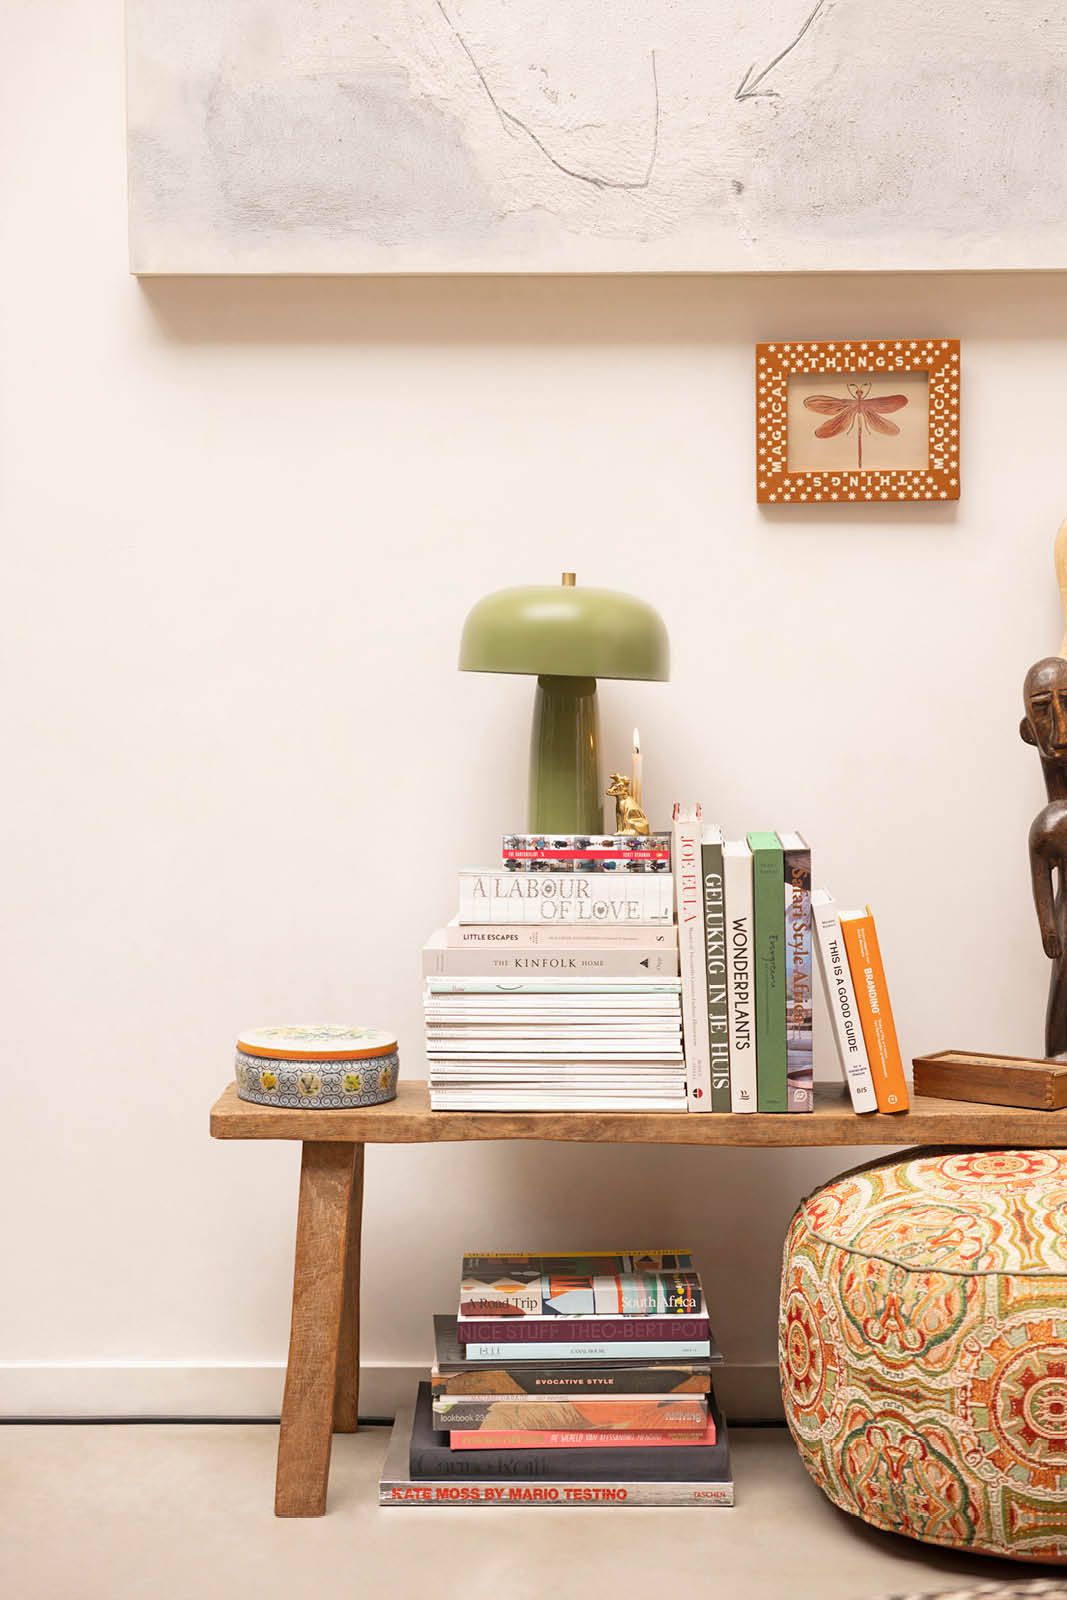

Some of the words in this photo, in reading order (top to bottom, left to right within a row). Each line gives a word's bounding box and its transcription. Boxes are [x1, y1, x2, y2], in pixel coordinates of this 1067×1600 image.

[808, 356, 905, 368] THINGS
[772, 371, 782, 472] MAGICAL
[934, 368, 945, 470] MAGICAL
[813, 475, 908, 487] THINGS
[680, 835, 695, 869] JOE
[472, 878, 488, 898] A
[494, 878, 592, 898] LABOUR
[682, 874, 697, 923] EULA
[791, 868, 810, 918] Safari
[540, 900, 576, 920] OF
[577, 900, 640, 920] LOVE
[704, 873, 726, 974] GELUKKIG
[463, 933, 486, 941] LITTLE
[487, 933, 519, 941] ESCAPES
[788, 923, 809, 965] Style
[829, 940, 839, 962] THIS
[515, 958, 577, 968] KINFOLK
[833, 962, 842, 976] IS
[708, 984, 727, 1004] IN
[732, 917, 750, 1051] WONDERPLANTS
[836, 978, 844, 989] A
[792, 972, 810, 1024] Africa
[838, 990, 851, 1018] GOOD
[709, 1013, 728, 1034] JE
[844, 1020, 858, 1053] GUIDE
[711, 1042, 730, 1089] HUIS
[469, 1298, 477, 1309] A
[480, 1297, 509, 1309] Road
[512, 1297, 538, 1310] Trip
[621, 1296, 657, 1308] South
[663, 1295, 697, 1308] Africa
[459, 1322, 500, 1341] NICE
[506, 1322, 560, 1340] STUFF
[569, 1320, 666, 1340] THEO-BERT
[671, 1319, 708, 1338] POT
[440, 1413, 473, 1422] lookbook
[391, 1487, 431, 1500] KATE
[436, 1487, 481, 1500] MOSS
[485, 1487, 505, 1500] BY
[509, 1487, 559, 1500] MARIO
[563, 1487, 627, 1500] TESTINO
